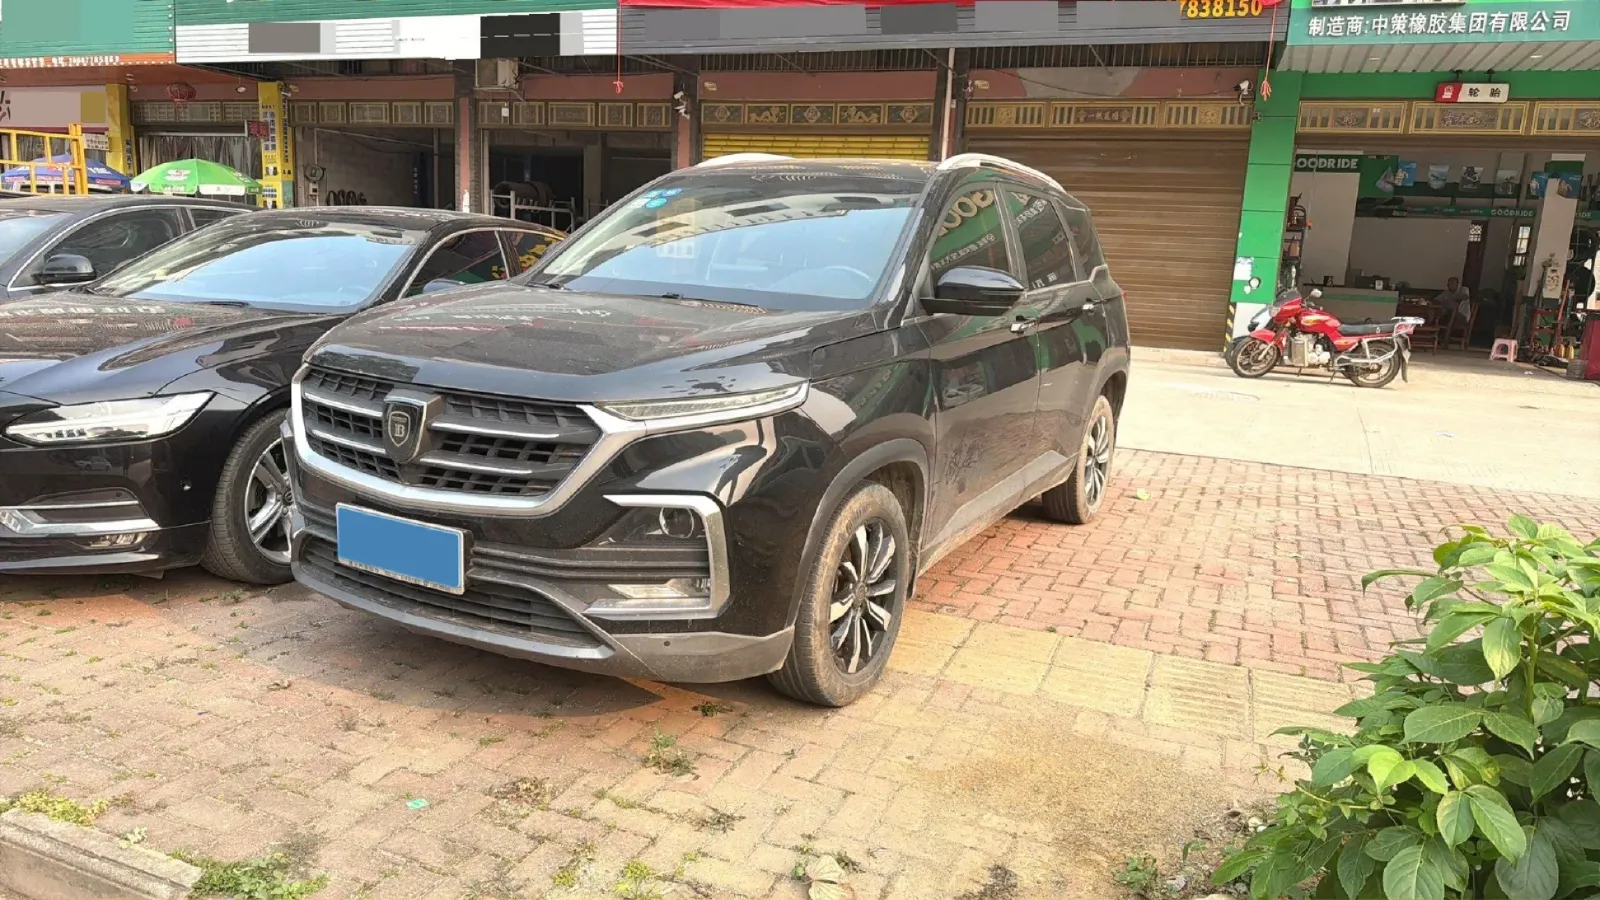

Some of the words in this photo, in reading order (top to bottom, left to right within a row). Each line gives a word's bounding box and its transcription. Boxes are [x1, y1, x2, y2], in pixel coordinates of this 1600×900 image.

[1468, 87, 1502, 98] 轮胎
[1294, 157, 1359, 169] OODRIDE
[1490, 208, 1534, 217] GOODRIDE
